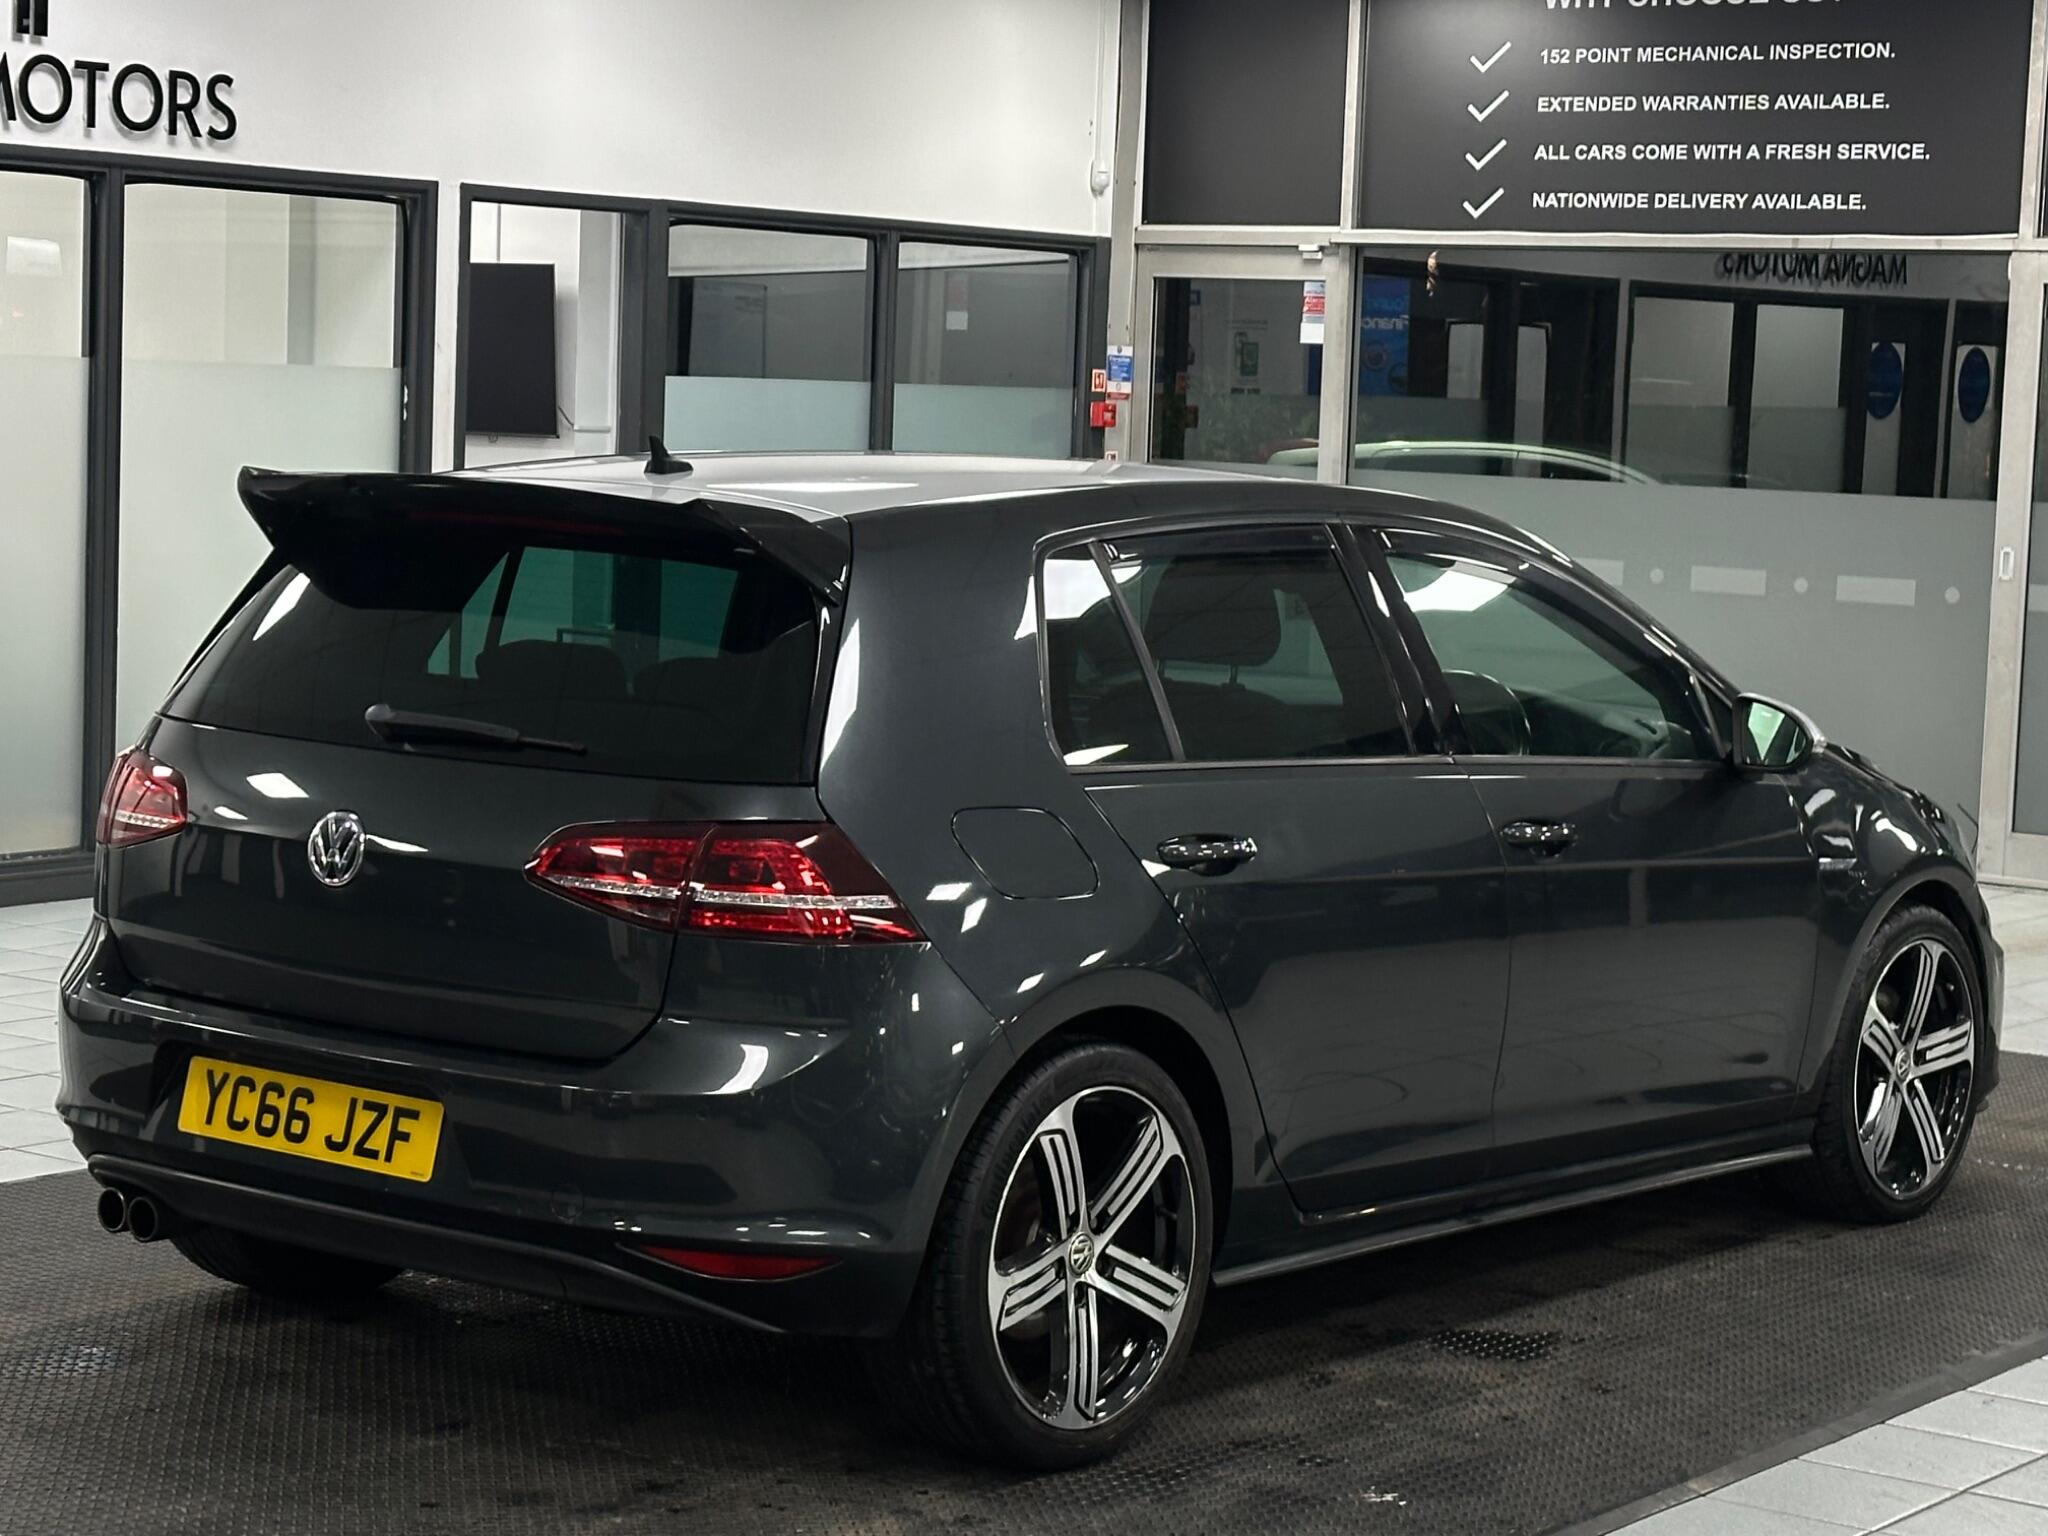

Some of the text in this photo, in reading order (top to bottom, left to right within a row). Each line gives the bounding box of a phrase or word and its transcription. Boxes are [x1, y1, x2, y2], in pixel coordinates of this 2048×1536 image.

[1540, 42, 1896, 65] 152 POINT MECHANICAL INSPECTION.
[1537, 92, 1890, 113] EXTENDED WARRANTIES AVAILABLE.
[1533, 143, 1930, 161] ALL CARS COME WITH A FRESH SERVICE.
[1532, 191, 1867, 210] NATIONWIDE DELIVERY AVAILABLE.
[205, 1068, 421, 1164] YC66 JZF
